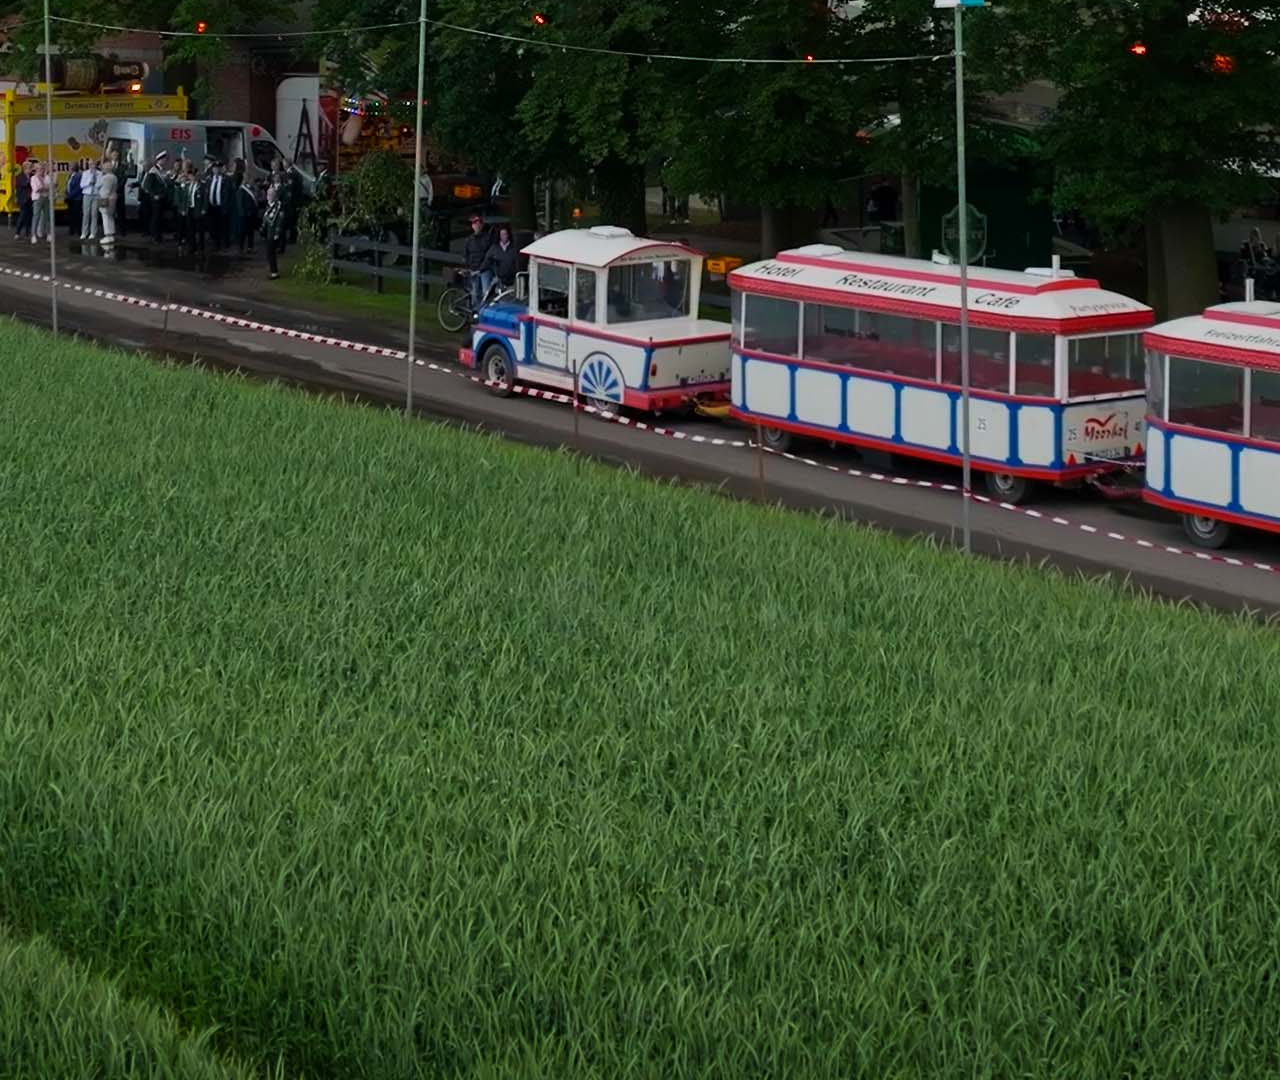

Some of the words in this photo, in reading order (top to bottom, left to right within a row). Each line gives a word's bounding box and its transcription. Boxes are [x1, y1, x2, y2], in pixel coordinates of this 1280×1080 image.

[171, 128, 192, 140] EIS
[754, 263, 805, 278] Hotel
[835, 273, 937, 298] Restaurant
